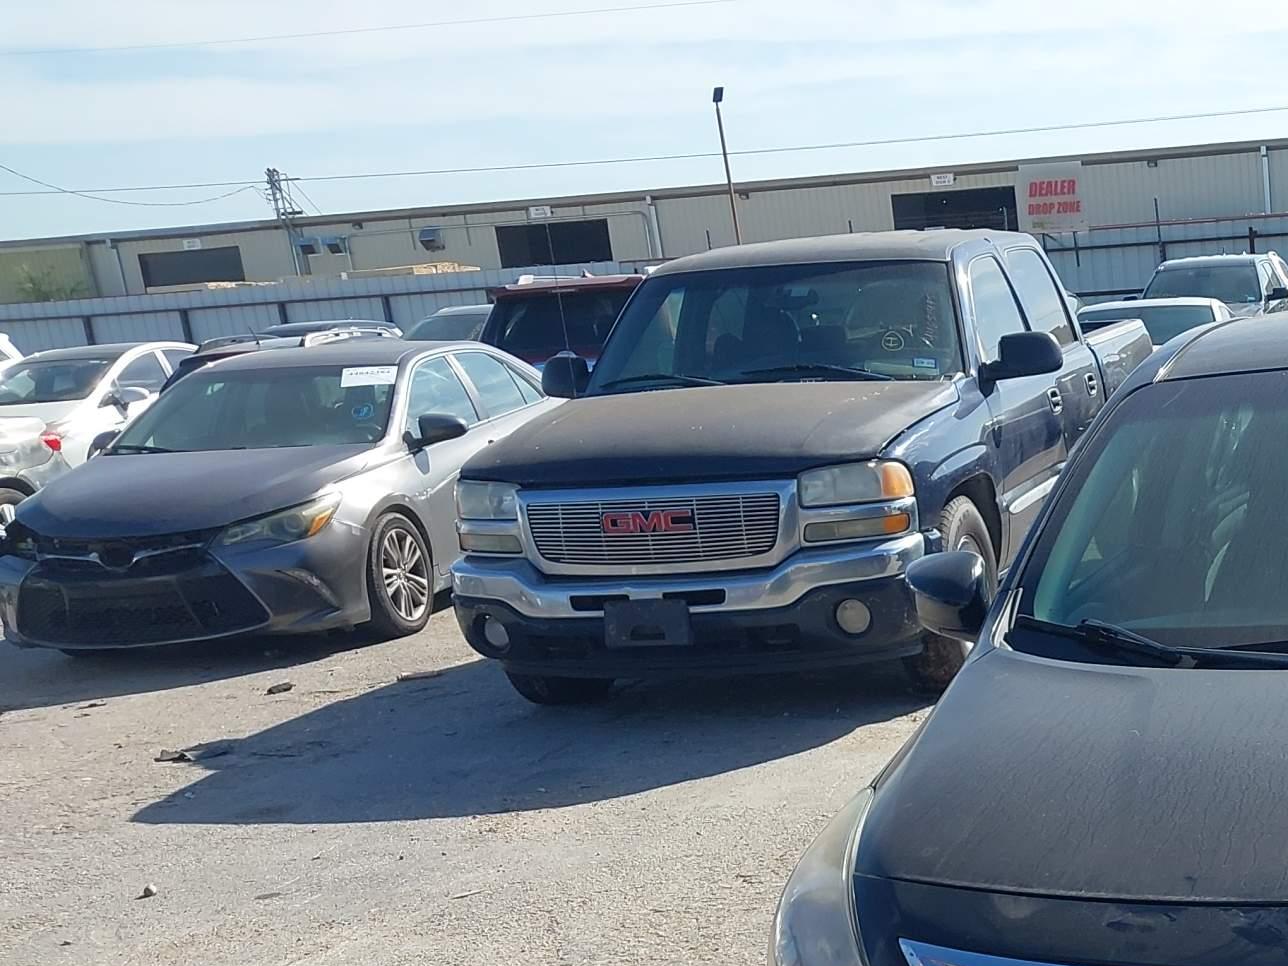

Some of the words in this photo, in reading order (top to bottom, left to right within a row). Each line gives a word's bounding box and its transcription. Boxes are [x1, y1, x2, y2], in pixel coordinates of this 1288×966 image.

[1028, 179, 1076, 198] DEALER
[1028, 202, 1056, 216] DROP
[1056, 200, 1081, 214] ZONE
[602, 509, 694, 533] GMC
